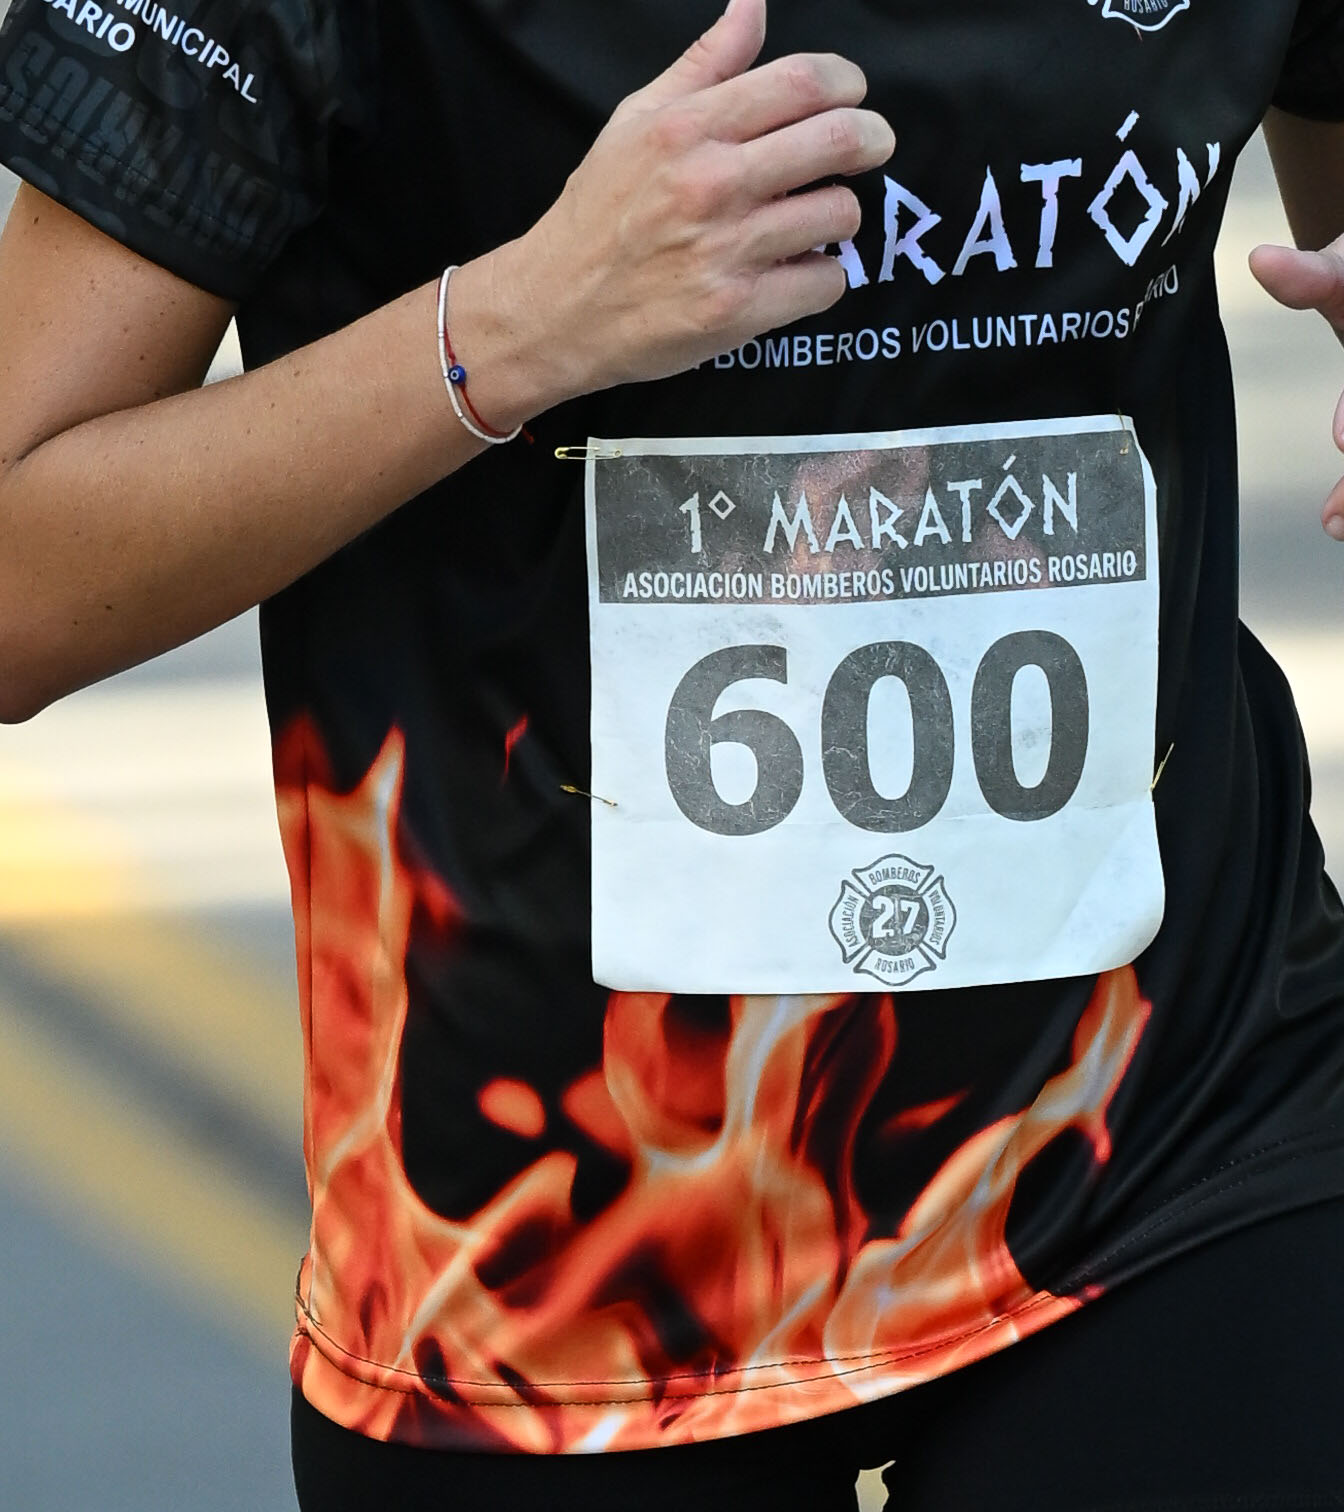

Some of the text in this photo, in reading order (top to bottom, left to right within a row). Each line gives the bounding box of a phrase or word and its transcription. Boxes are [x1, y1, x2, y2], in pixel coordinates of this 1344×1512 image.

[714, 327, 902, 370] BOMBEROS
[911, 307, 1130, 353] VOLUNTARIOS
[762, 455, 1078, 554] MARATÓN
[622, 550, 1137, 599] ASOCIACIÓN BOMBEROS VOLUNTARIOS ROSARIO
[665, 630, 1090, 836] 600
[868, 866, 921, 886] BOMBEROS
[872, 894, 921, 939] 27
[875, 957, 915, 974] ROSARIO
